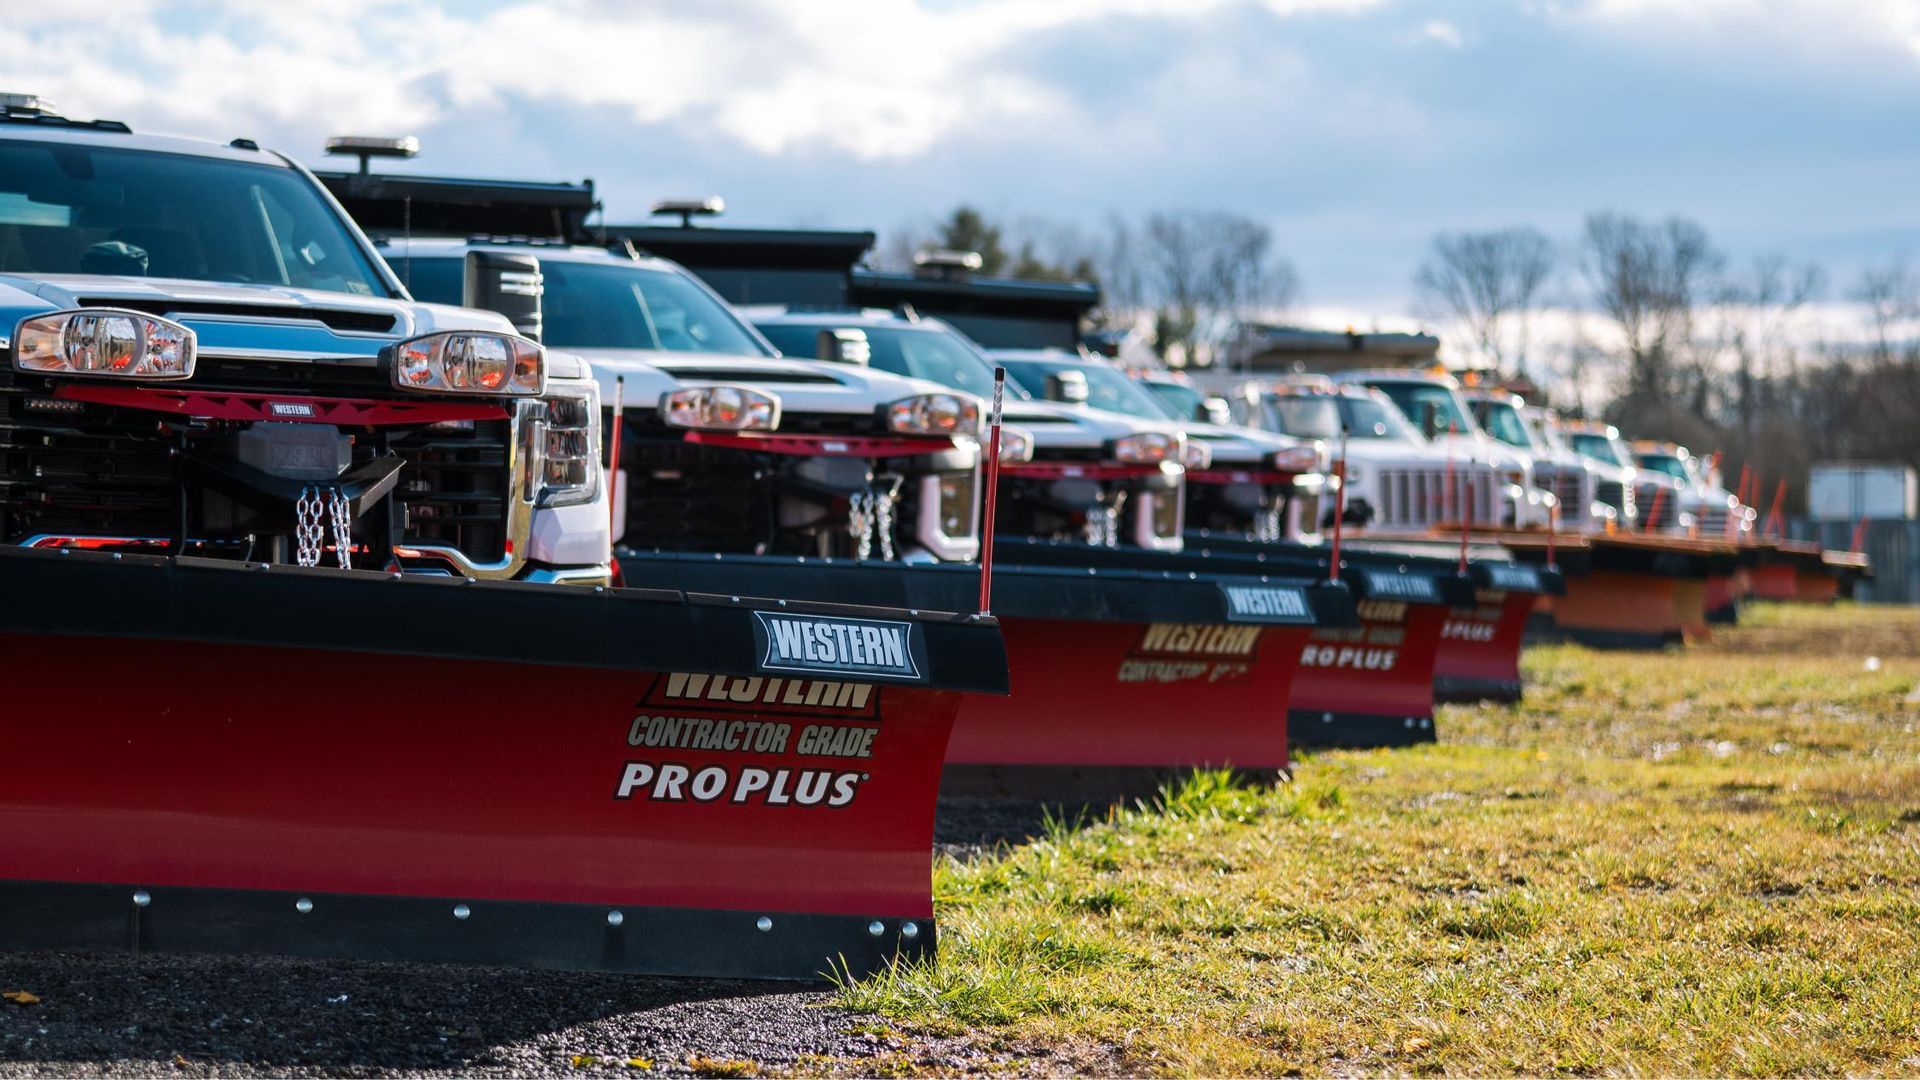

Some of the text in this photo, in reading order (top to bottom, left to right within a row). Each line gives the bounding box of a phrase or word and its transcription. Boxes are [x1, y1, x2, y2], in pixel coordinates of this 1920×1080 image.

[274, 404, 311, 416] WESTERN
[1226, 587, 1306, 616] WESTERN
[772, 618, 904, 668] WESTERN
[1300, 644, 1396, 671] RO PLUS
[627, 715, 880, 758] CONTRACTOR GRADE
[617, 762, 728, 801] PRO
